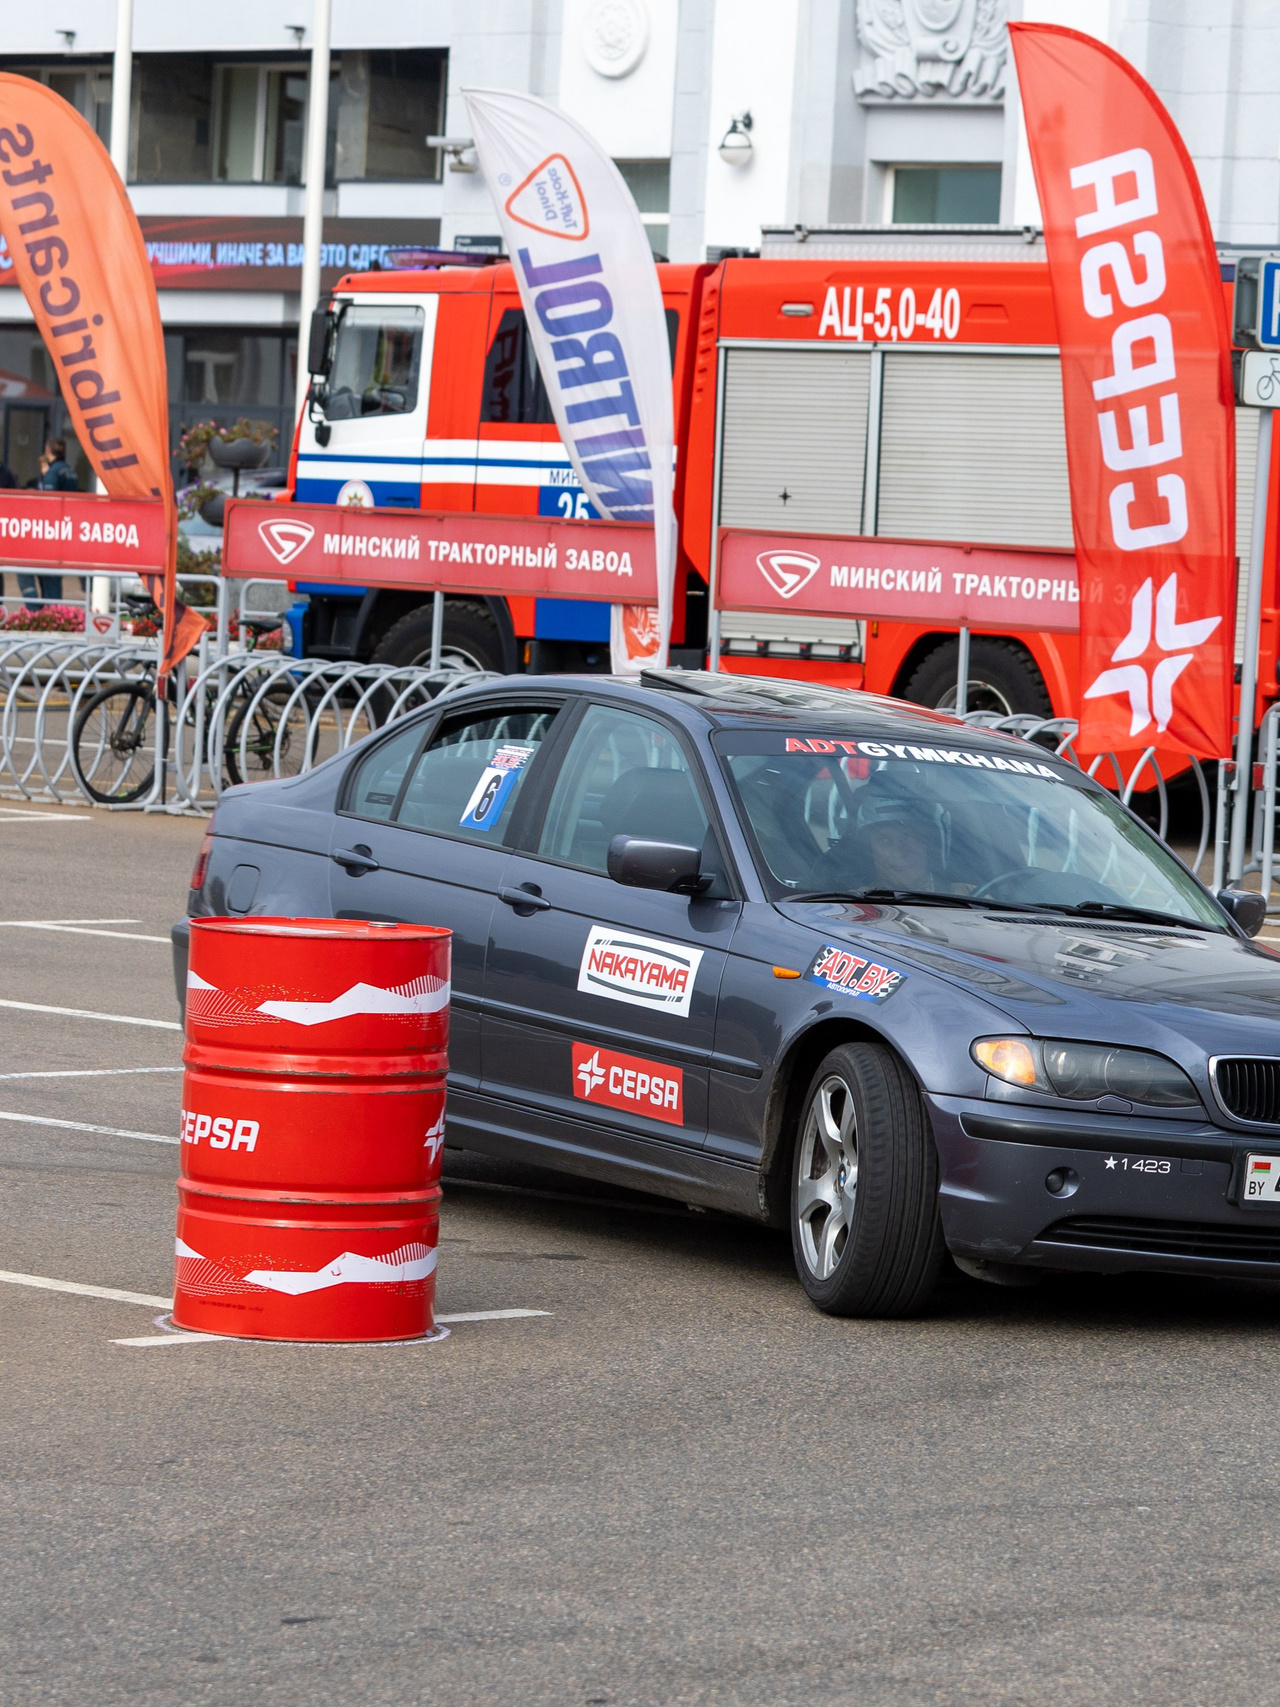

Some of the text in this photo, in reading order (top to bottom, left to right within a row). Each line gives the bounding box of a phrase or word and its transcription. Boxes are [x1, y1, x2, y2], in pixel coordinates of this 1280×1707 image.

[216, 242, 264, 266] ИНАЧЕ
[818, 286, 961, 341] АЦ-5,0-40
[79, 521, 139, 548] ЗАВОД
[323, 533, 633, 577] МИНСКИЙ ТРАКТОРНЫЙ ЗАВОД
[830, 565, 942, 594] МИНСКИЙ
[474, 774, 503, 821] 6
[588, 948, 689, 993] NAKAYAMA
[814, 948, 899, 996] ADT.BY
[609, 1066, 679, 1110] CEPSA
[1121, 1158, 1171, 1174] 1423
[1249, 1181, 1265, 1196] BY
